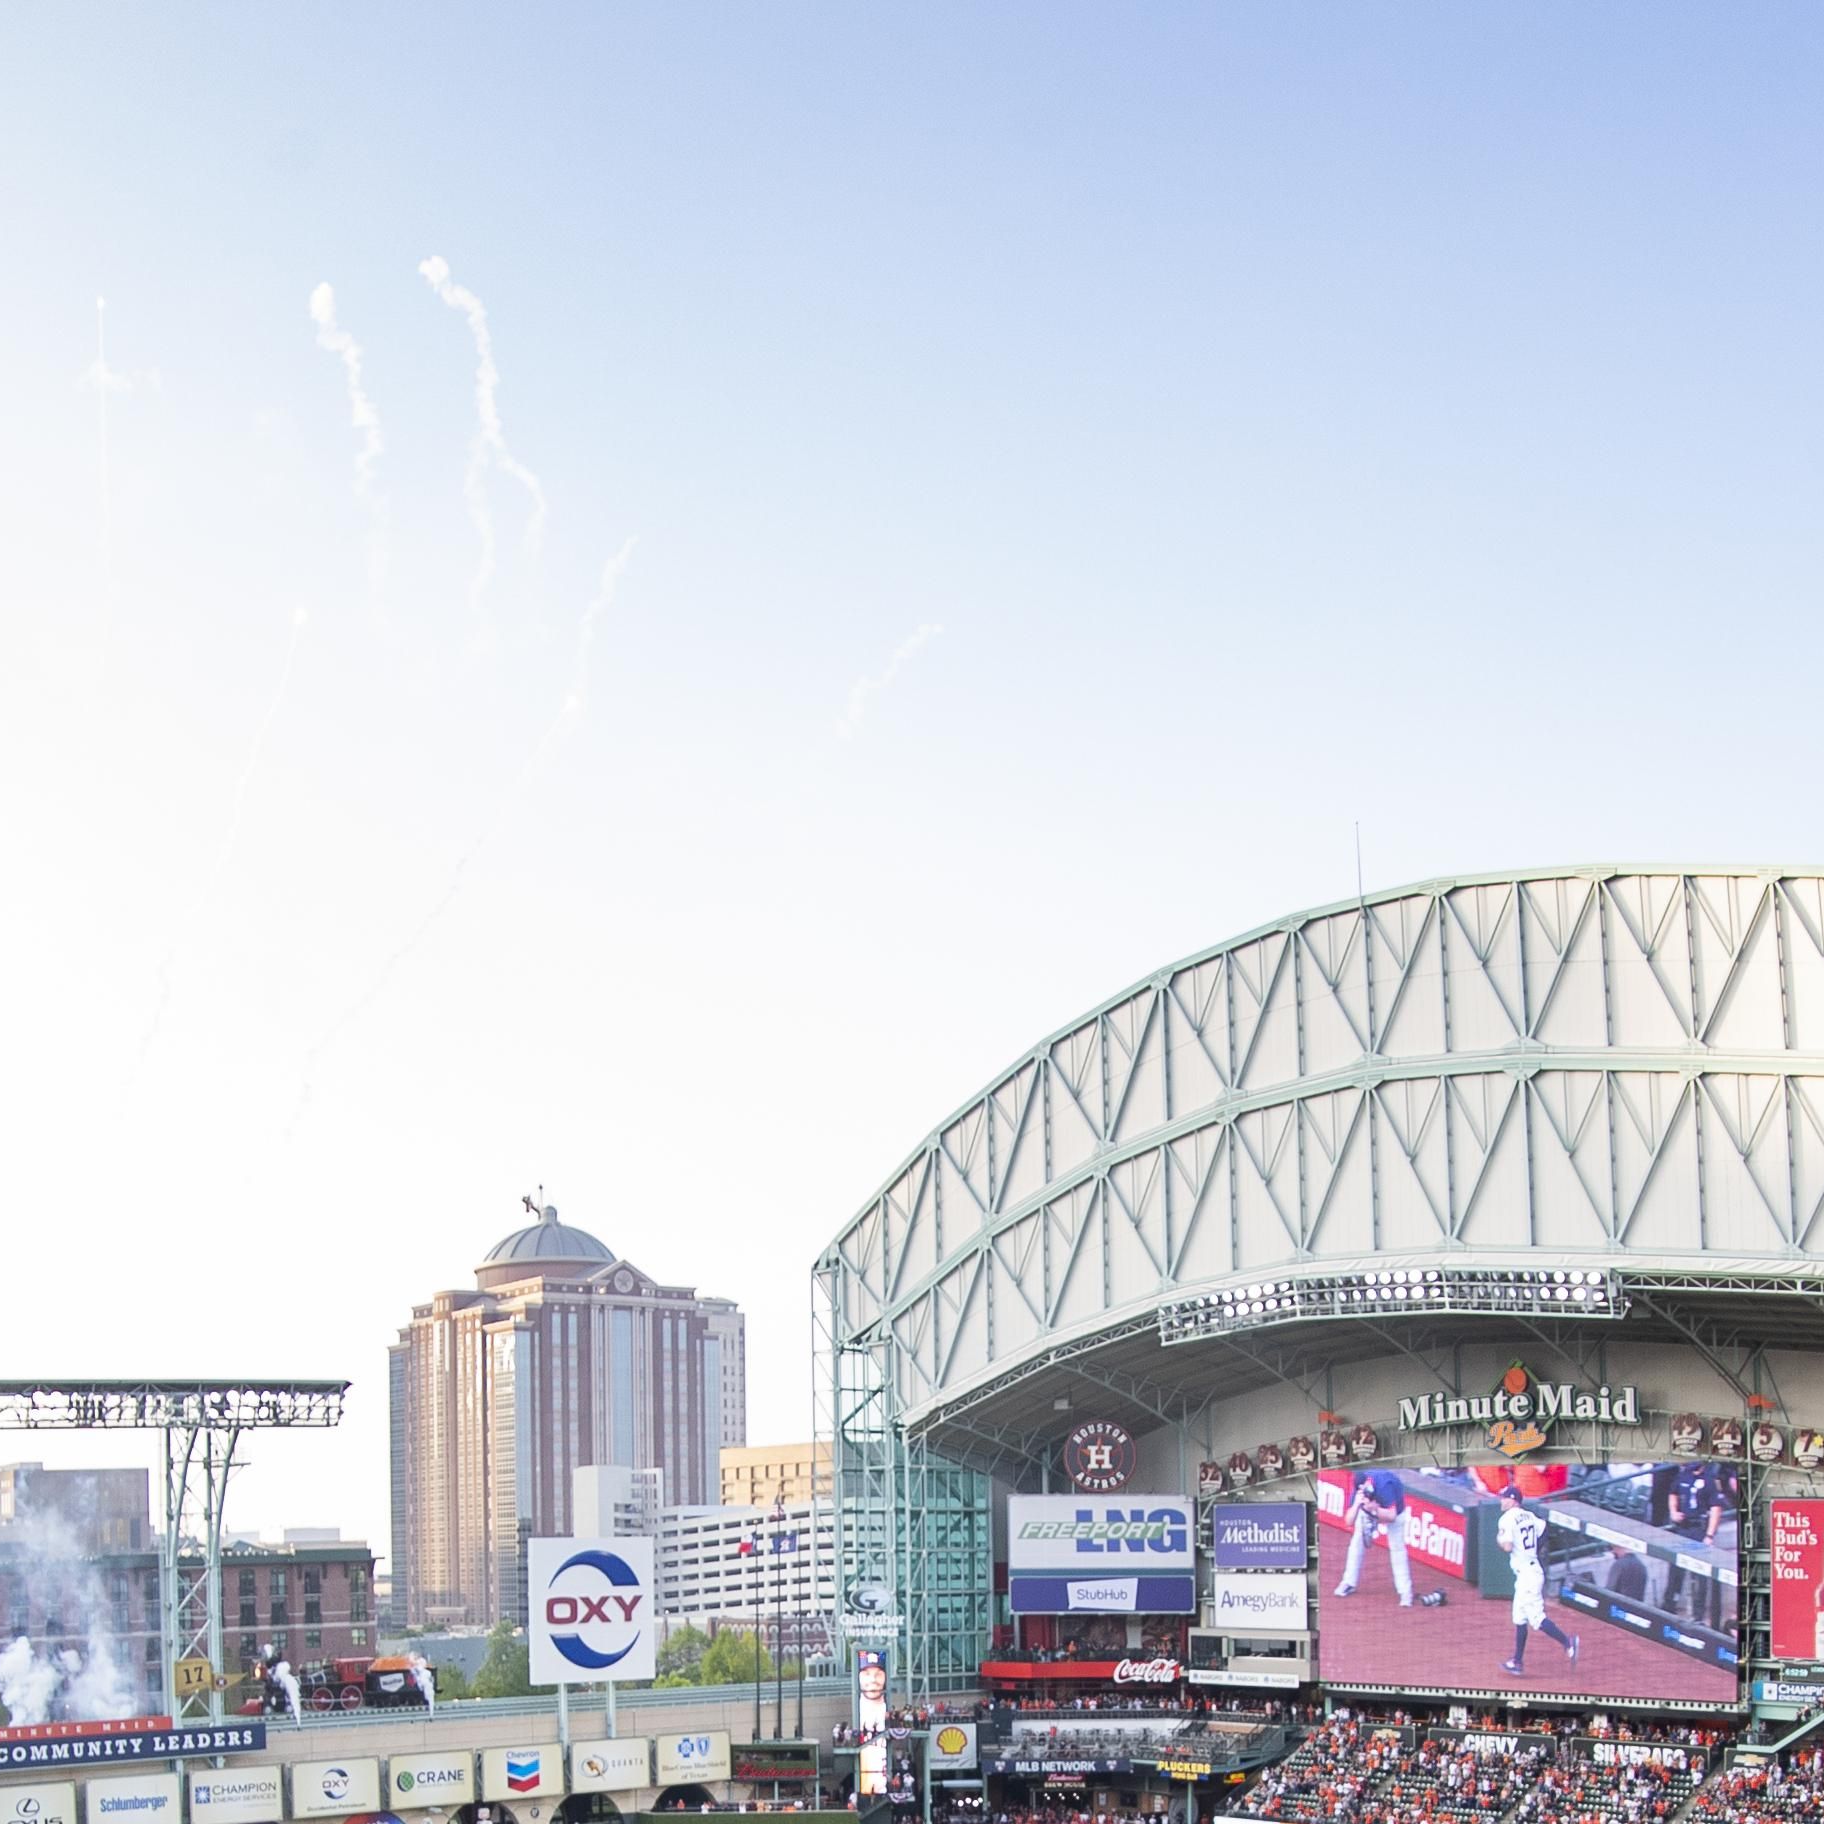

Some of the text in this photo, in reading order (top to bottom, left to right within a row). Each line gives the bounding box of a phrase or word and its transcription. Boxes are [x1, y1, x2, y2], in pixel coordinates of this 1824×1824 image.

[1398, 1384, 1638, 1430] Minute Maid
[1073, 1422, 1128, 1445] HOUSTON
[1488, 1420, 1545, 1452] Park
[1711, 1417, 1739, 1440] 24
[1759, 1422, 1772, 1446] 5
[1800, 1429, 1815, 1453] 7
[1087, 1445, 1113, 1470] H
[1075, 1470, 1126, 1490] ASTROS
[1773, 1511, 1810, 1528] This
[1022, 1508, 1187, 1553] FREEPORT LNG
[1220, 1522, 1301, 1544] Methodist
[1405, 1506, 1464, 1565] teFarm
[1774, 1528, 1818, 1545] Bud's
[1774, 1546, 1802, 1562] For
[1774, 1563, 1809, 1580] You.
[1076, 1588, 1128, 1601] StubHub
[1221, 1590, 1299, 1613] AmegyBank
[545, 1593, 643, 1625] OXY
[839, 1612, 905, 1630] Gallagher
[845, 1628, 899, 1637] INSURANCE
[183, 1666, 204, 1685] 17
[0, 1720, 155, 1739] MINUTE MAID
[153, 1729, 254, 1751] LEADERS
[1463, 1734, 1518, 1754] CHEVY
[506, 1750, 540, 1760] Chevron
[1592, 1742, 1686, 1766] SILVERADO
[1015, 1760, 1096, 1772] MLB NETWORK
[1157, 1760, 1211, 1775] PLUCKERS
[321, 1777, 350, 1790] OXY
[416, 1769, 464, 1784] CRANE
[212, 1782, 276, 1796] CHAMPION
[100, 1795, 168, 1813] Schlumberger
